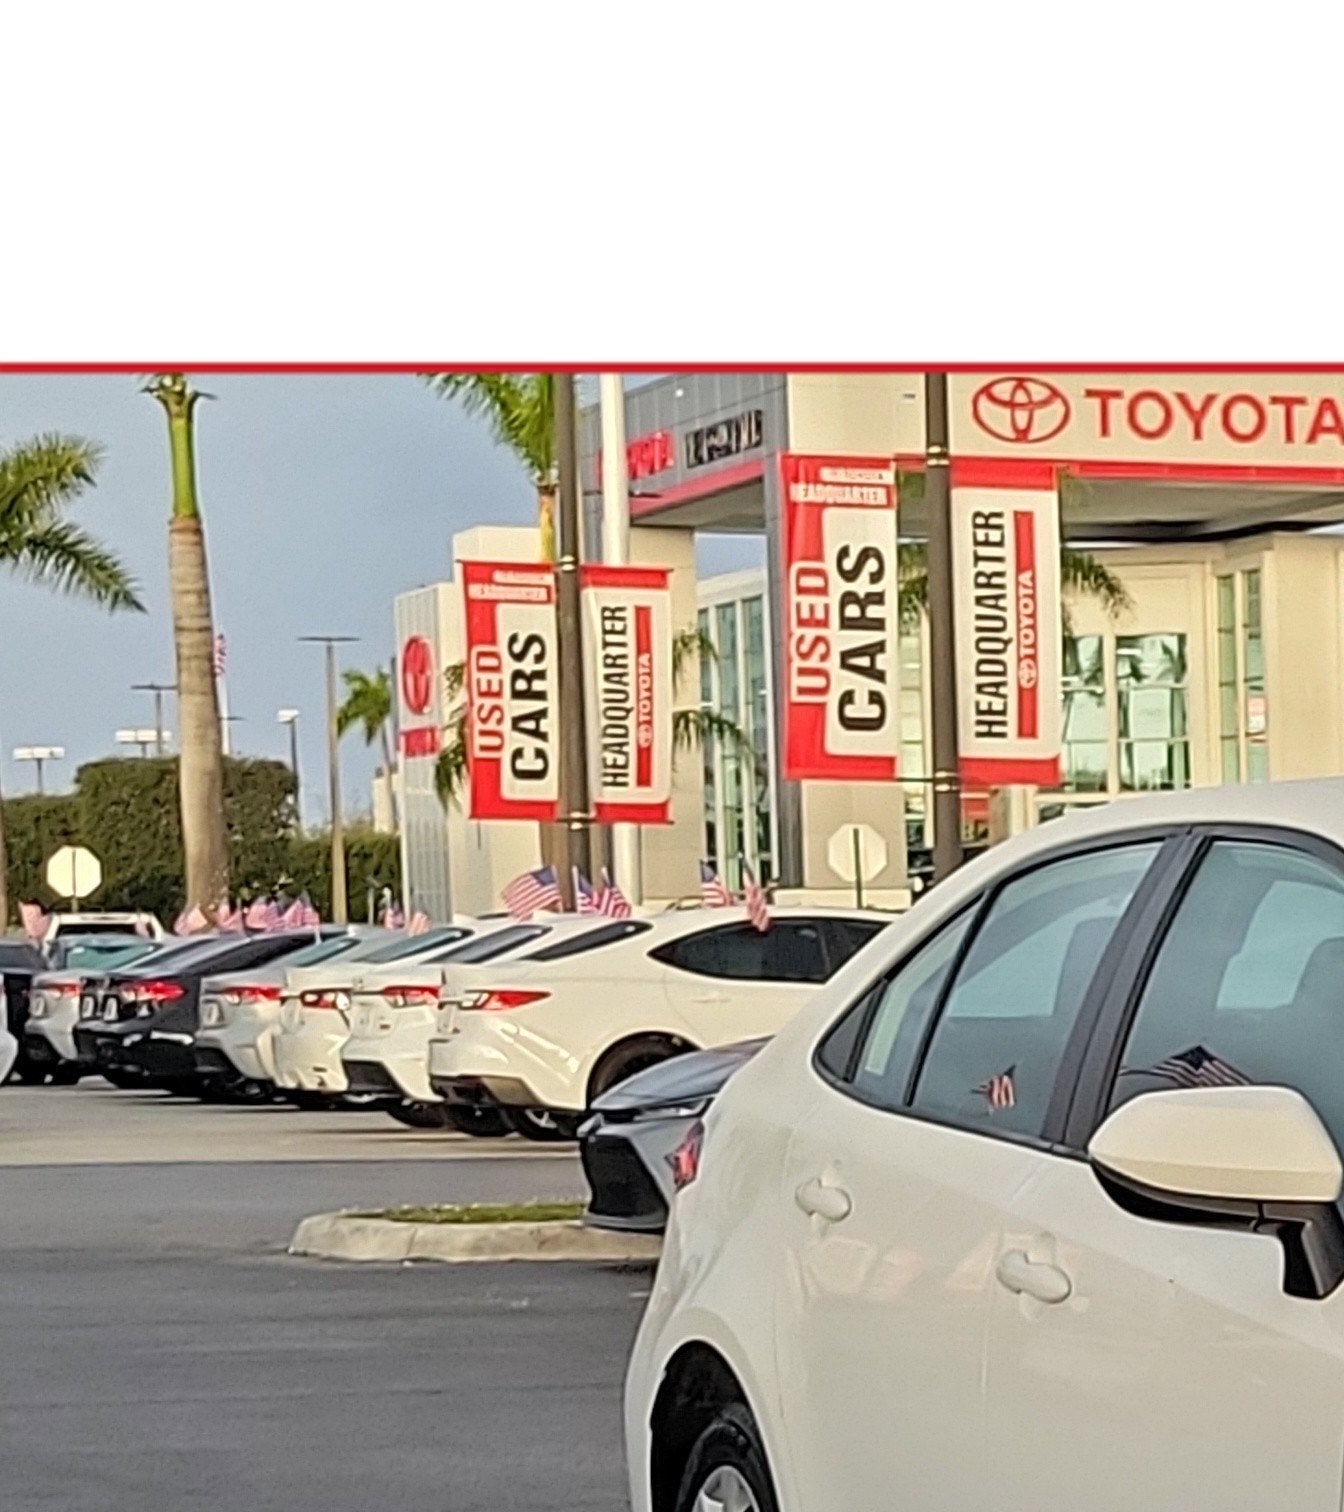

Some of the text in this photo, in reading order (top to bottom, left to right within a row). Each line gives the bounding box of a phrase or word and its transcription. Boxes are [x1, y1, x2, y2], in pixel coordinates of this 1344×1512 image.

[795, 569, 831, 697] USED
[836, 545, 886, 731] CARS
[972, 511, 1013, 738] HEADQUARTER
[1018, 570, 1038, 658] TOYOTA
[476, 650, 505, 753] USED
[507, 632, 549, 781] CARS
[601, 605, 635, 788] HEADQUARTER
[637, 653, 654, 724] TOYOTA
